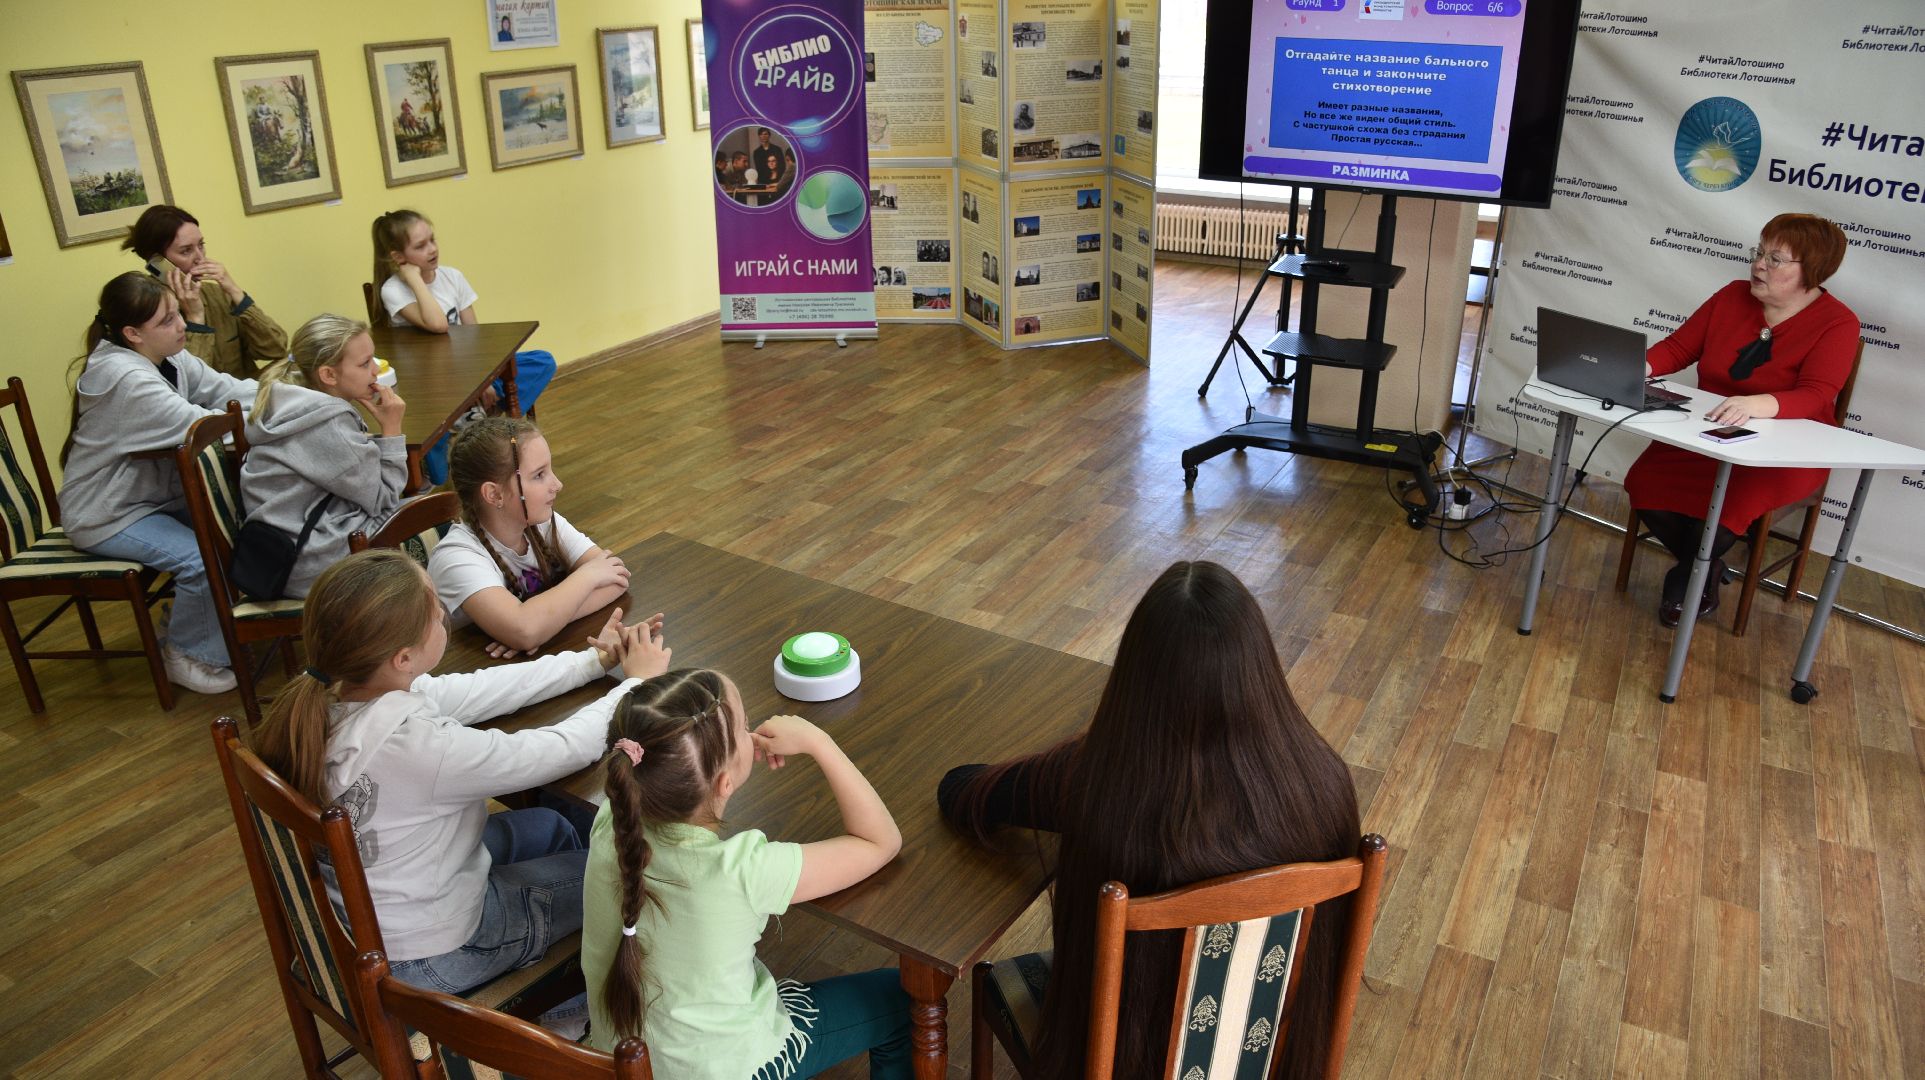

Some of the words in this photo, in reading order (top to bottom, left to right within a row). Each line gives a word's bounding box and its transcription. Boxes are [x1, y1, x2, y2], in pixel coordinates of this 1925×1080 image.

[1292, 0, 1322, 8] Раунд
[1436, 0, 1474, 13] Вопрос
[1487, 2, 1504, 13] 6/6
[1607, 26, 1658, 38] Лотошинья
[1862, 24, 1925, 37] #ЧитайЛот
[752, 34, 832, 71] БИБЛИО
[1842, 39, 1908, 52] Библиотеки
[1285, 48, 1352, 62] Отгадайте
[1355, 54, 1421, 65] название
[1424, 55, 1489, 68] бального
[1698, 54, 1785, 70] #ЧитайЛотошино
[754, 65, 835, 93] ДРАЙВ
[1321, 67, 1359, 78] танца
[1363, 69, 1371, 77] и
[1376, 70, 1447, 81] закончите
[1680, 67, 1738, 80] Библиотеки
[1739, 71, 1796, 85] Лотошинья
[1332, 82, 1433, 96] стихотворение
[1318, 101, 1349, 110] Имеет
[1351, 104, 1389, 113] разные
[1391, 106, 1444, 117] названия,
[1594, 110, 1644, 123] Лотошинья
[1304, 110, 1317, 119] Но
[1355, 115, 1385, 123] виден
[1388, 116, 1421, 126] общий
[1424, 119, 1457, 128] стиль.
[1293, 120, 1300, 128] С
[1302, 122, 1354, 132] частушкой
[1357, 126, 1389, 134] схожа
[1391, 126, 1410, 136] без
[1412, 129, 1466, 140] страдания
[1821, 121, 1925, 157] #Чита
[1331, 133, 1372, 143] Простая
[1373, 138, 1423, 147] русская...
[1332, 164, 1410, 181] РАЗМИНКА
[1581, 191, 1628, 207] Лотошинья
[1665, 227, 1743, 250] #ЧитайЛотошино
[1828, 219, 1912, 242] тайЛотошино
[1649, 236, 1702, 255] Библиотеки
[1862, 239, 1925, 259] Лотошинья
[735, 254, 790, 277] ИГРАЙ
[793, 259, 804, 276] С
[808, 258, 858, 276] НАМИ
[1534, 251, 1604, 272] #ЧитайЛотошино
[1521, 260, 1567, 277] Библиотеки
[1567, 270, 1613, 287] Лотошинья
[1633, 317, 1677, 334] Библиоте
[1496, 404, 1540, 423] Библиотеки
